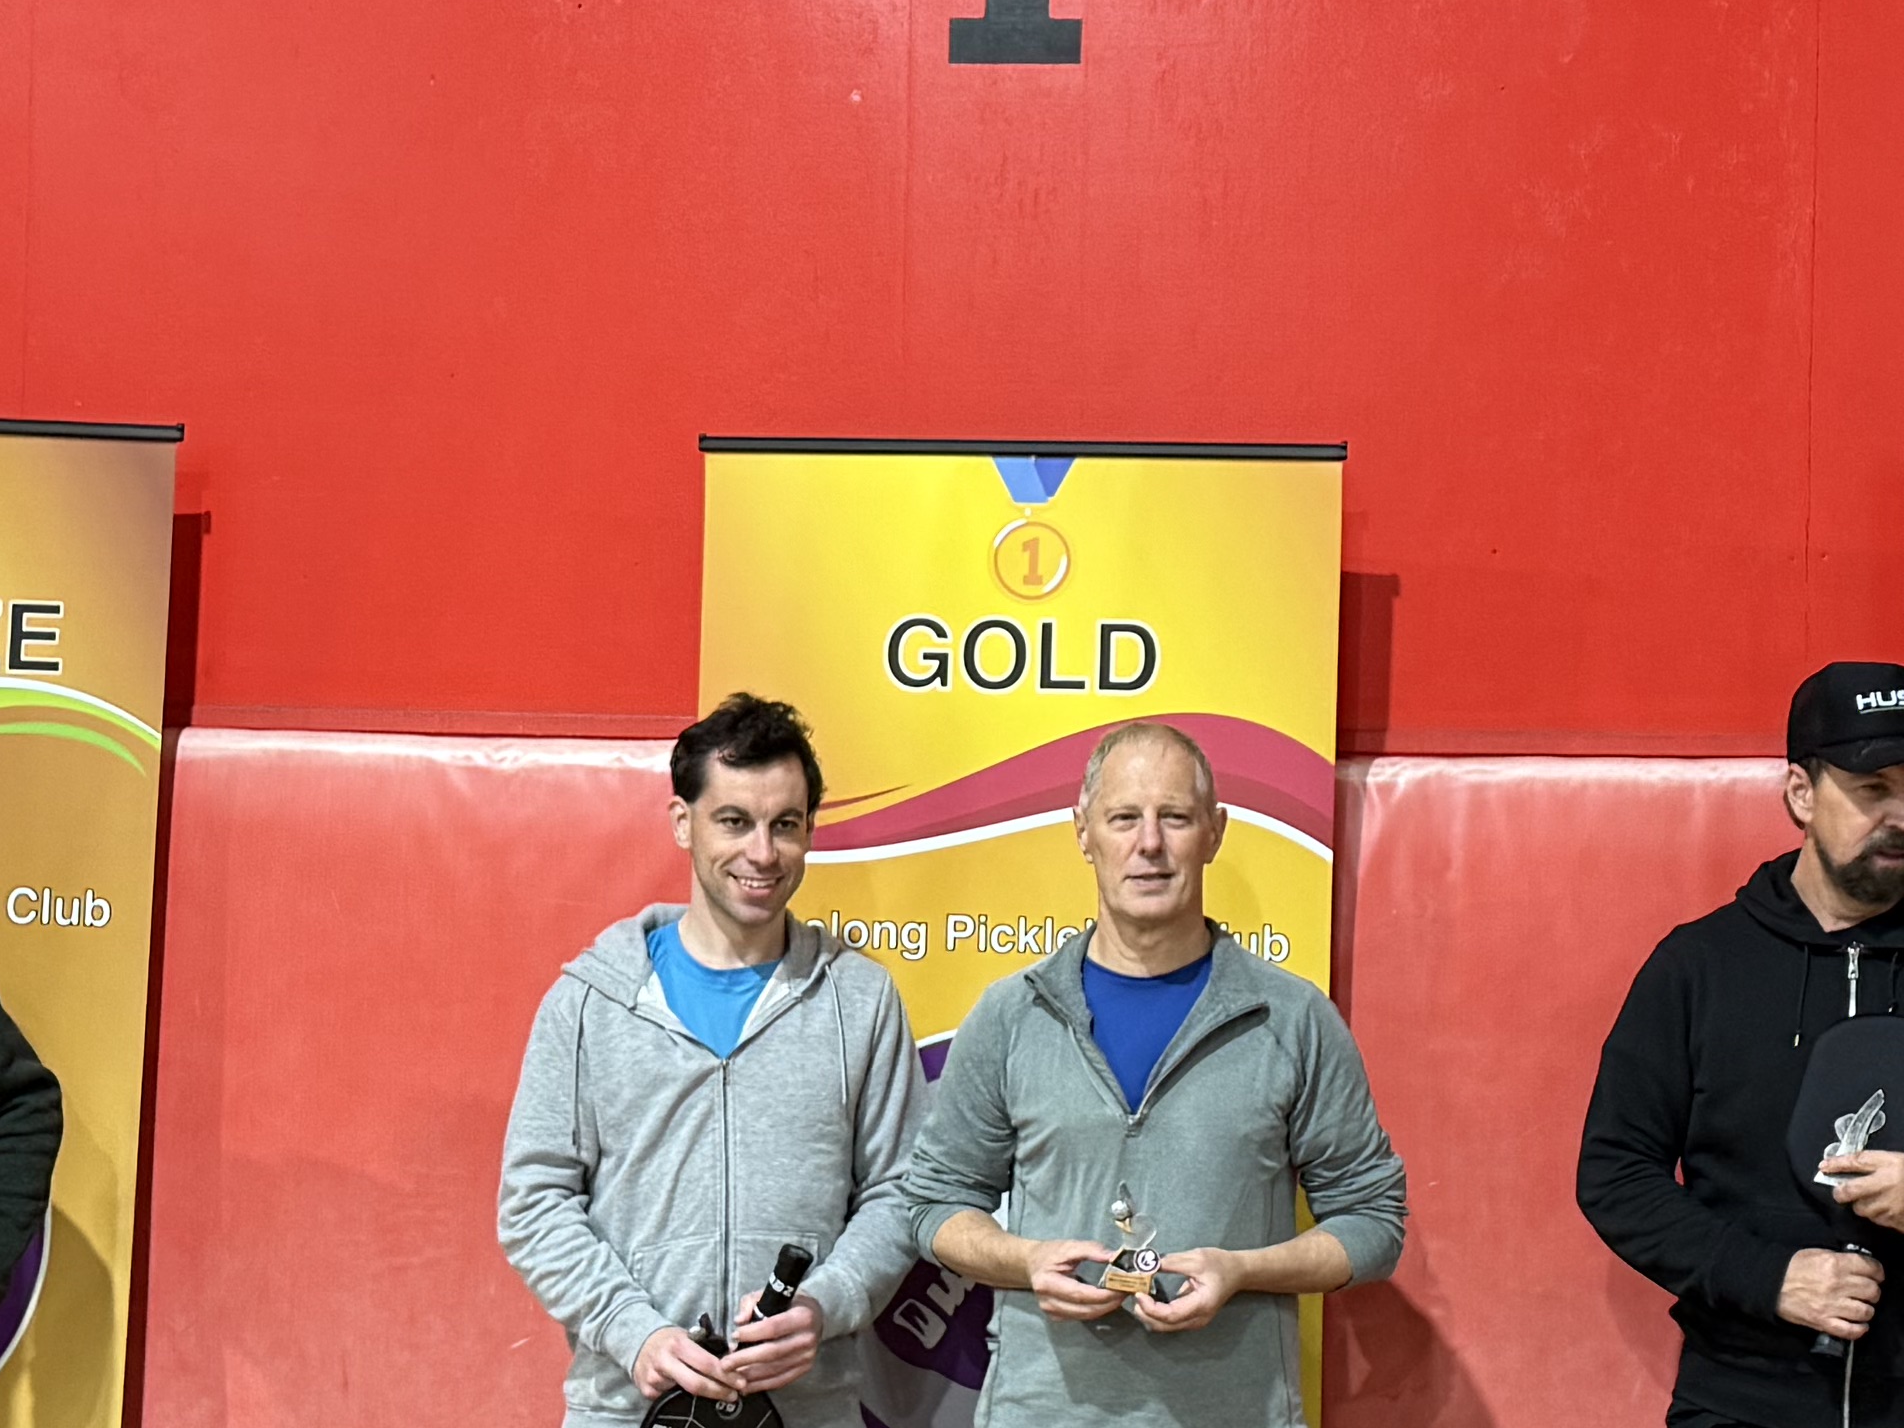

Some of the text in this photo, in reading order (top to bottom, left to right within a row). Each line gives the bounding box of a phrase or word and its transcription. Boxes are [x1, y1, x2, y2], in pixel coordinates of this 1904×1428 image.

[1020, 536, 1043, 586] 1
[885, 615, 1160, 692] GOLD
[6, 885, 112, 929] Club
[805, 910, 928, 961] long
